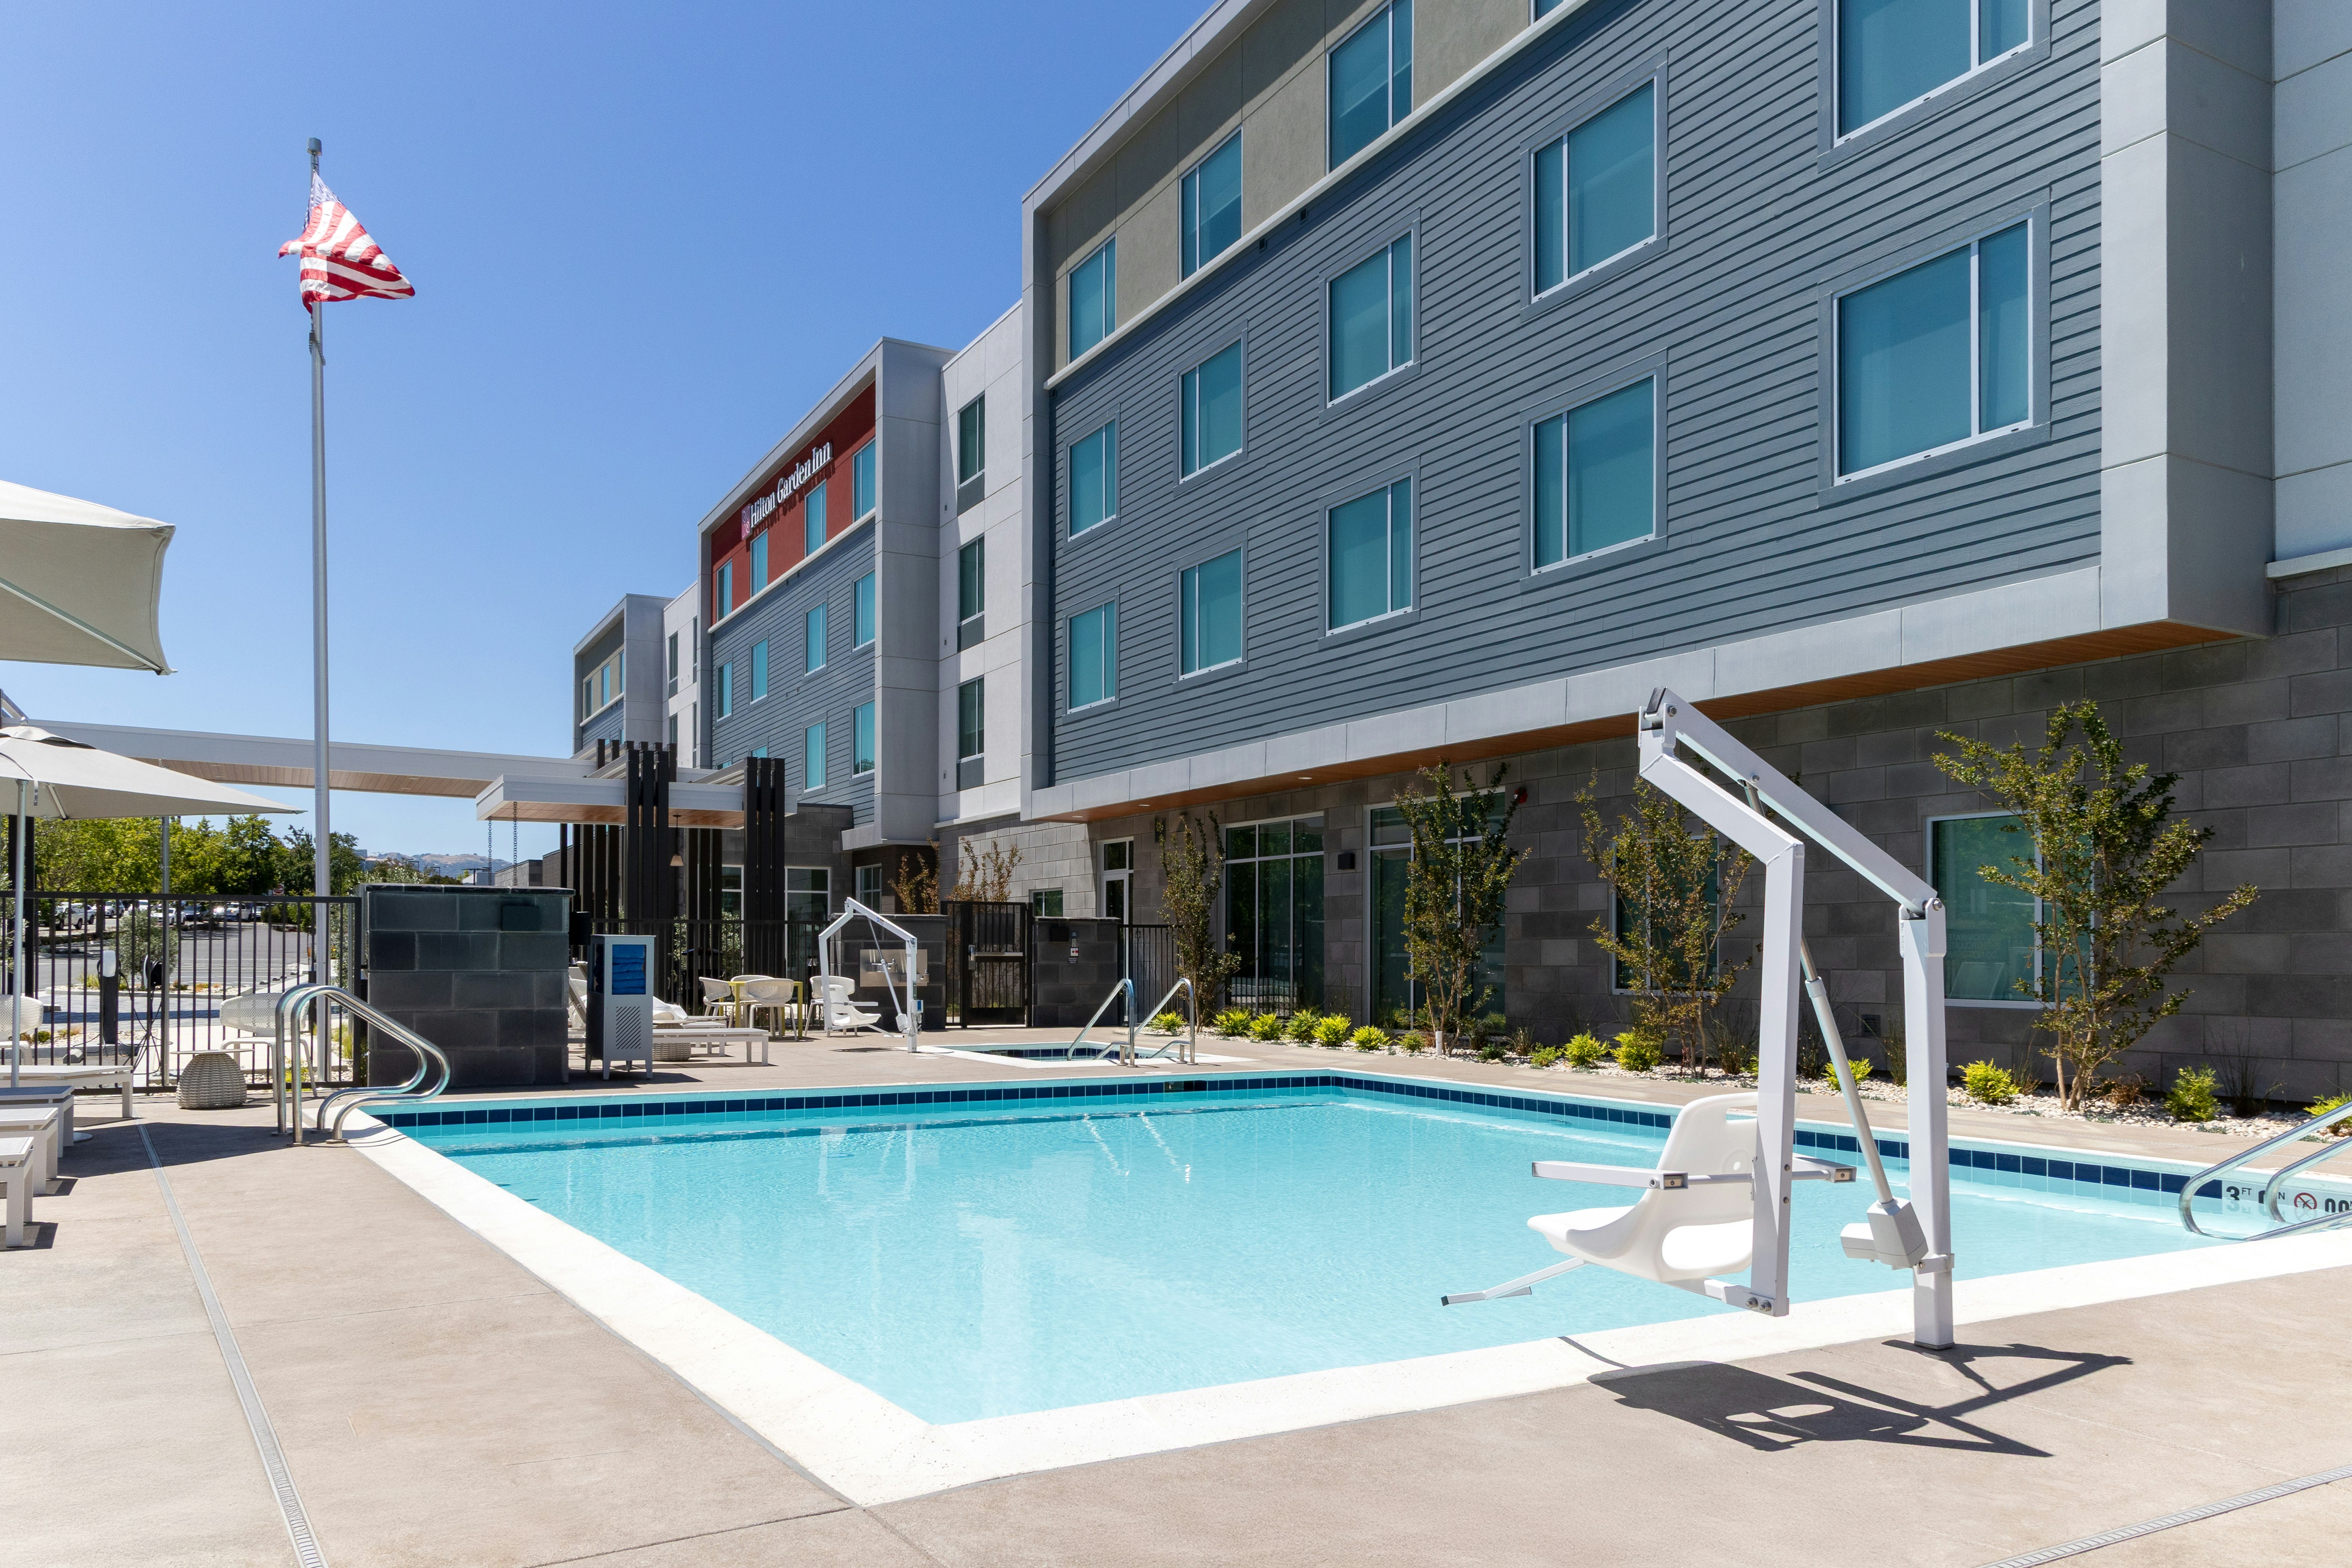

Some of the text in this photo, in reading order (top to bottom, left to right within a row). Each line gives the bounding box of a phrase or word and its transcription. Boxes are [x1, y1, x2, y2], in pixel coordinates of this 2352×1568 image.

[751, 442, 831, 528] Hilton Garden Inn
[2226, 1186, 2240, 1200] 3
[2241, 1187, 2252, 1196] FT
